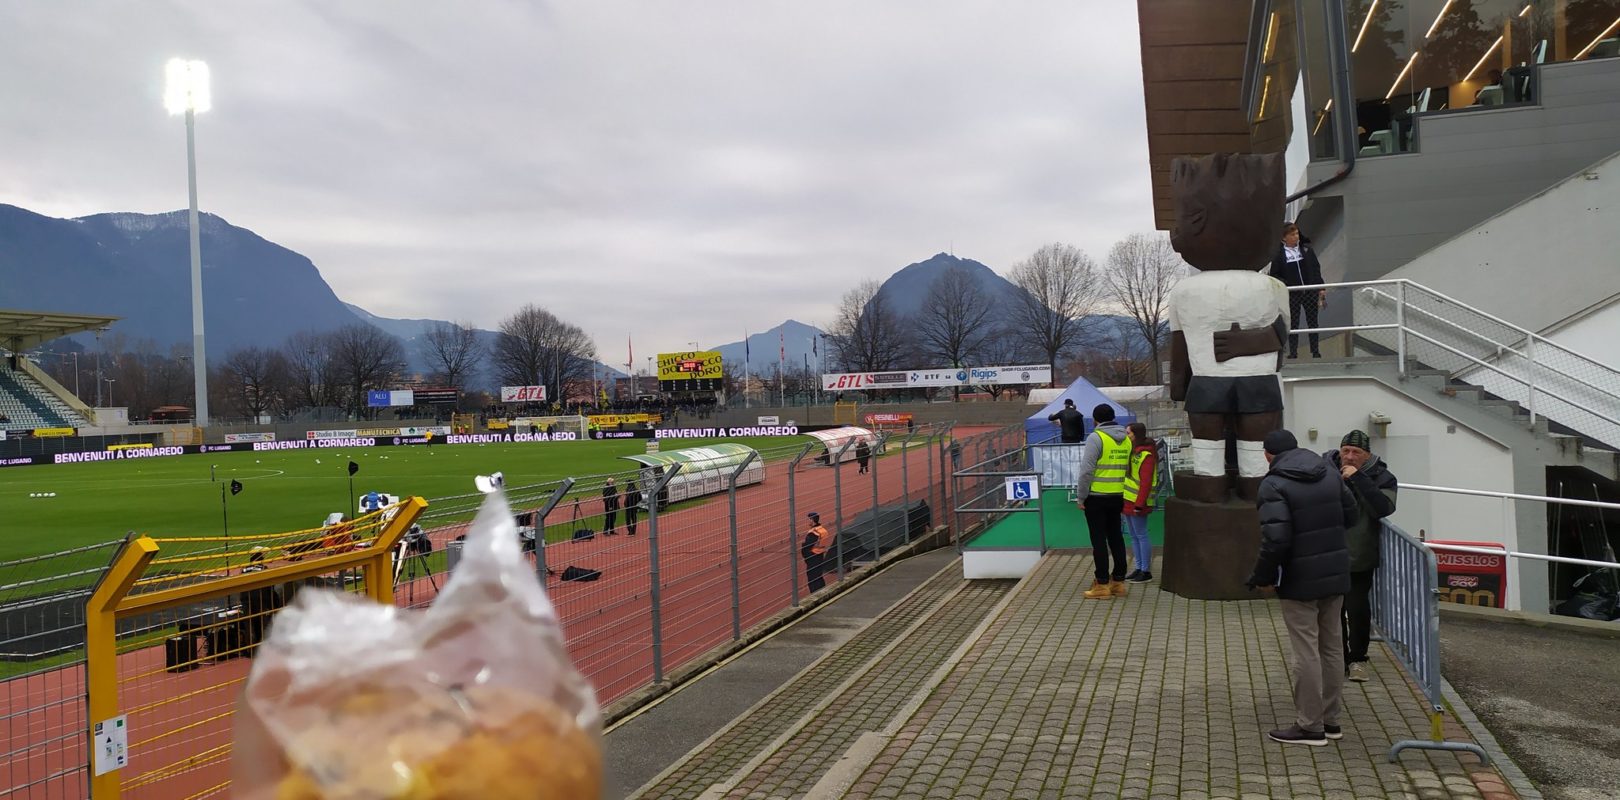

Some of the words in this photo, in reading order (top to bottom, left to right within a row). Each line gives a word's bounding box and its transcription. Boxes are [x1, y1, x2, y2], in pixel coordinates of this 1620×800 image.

[971, 369, 998, 380] Rigips
[837, 375, 862, 389] GTL
[516, 387, 545, 400] GTL
[338, 430, 354, 438] Image
[446, 432, 502, 444] BENVENUTI
[503, 433, 511, 442] A
[513, 431, 576, 442] CORNAREDO
[655, 428, 716, 438] BENVENUTI
[718, 428, 727, 437] A
[729, 426, 798, 436] CORNAREDO
[253, 440, 307, 451] BENVENUTI
[309, 440, 316, 448] A
[318, 437, 376, 448] CORNAREDO
[54, 451, 114, 464] BENVENUTI
[116, 450, 124, 459] A
[126, 446, 184, 459] CORNAREDO
[1436, 554, 1500, 567] WISSLOS
